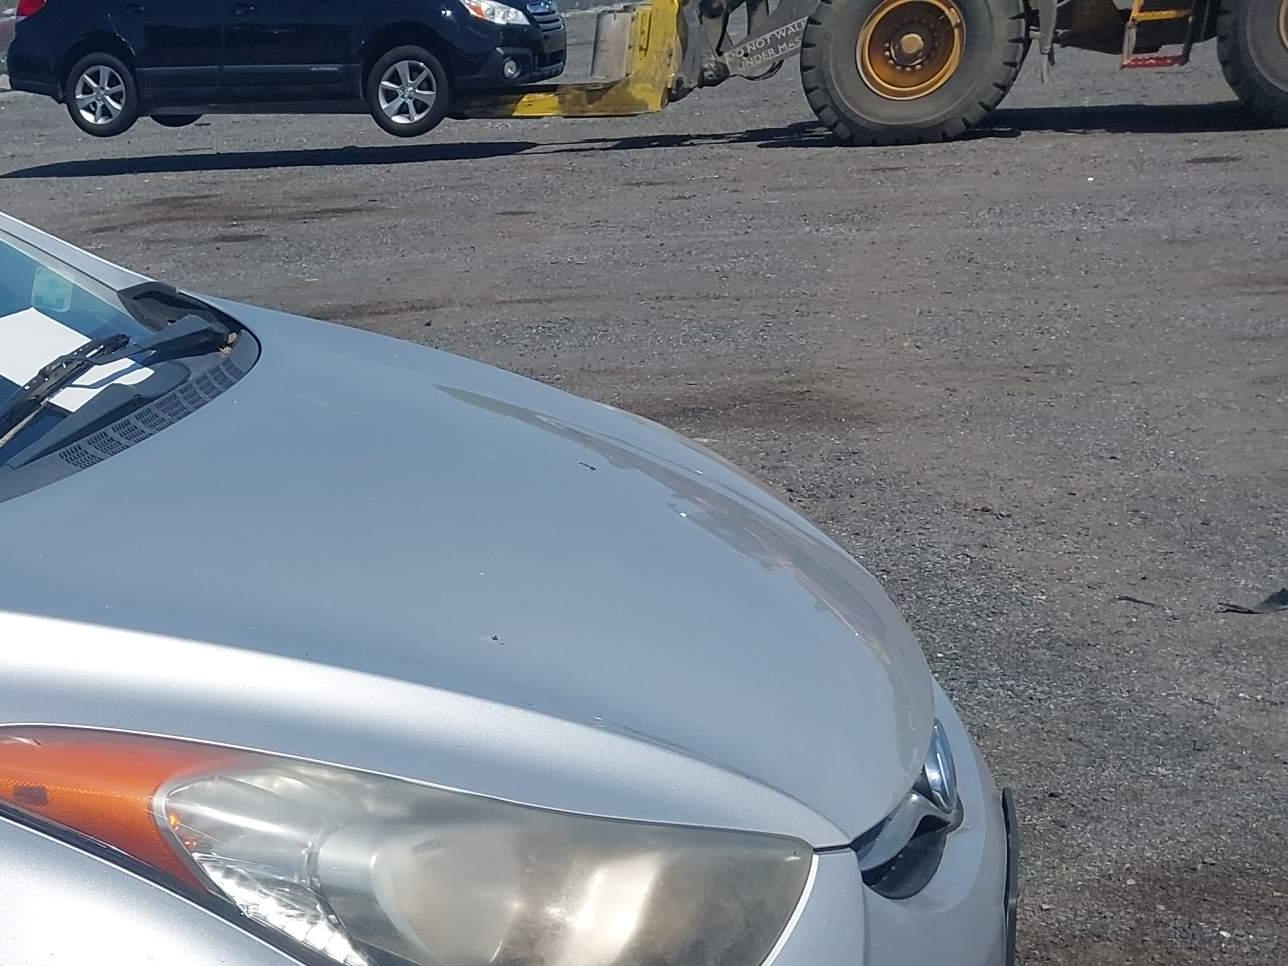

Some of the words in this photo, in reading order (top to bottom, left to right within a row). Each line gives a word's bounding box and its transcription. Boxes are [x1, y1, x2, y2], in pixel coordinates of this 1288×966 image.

[737, 48, 776, 70] UNDER
[778, 36, 802, 55] MAS
[746, 33, 773, 53] NOT
